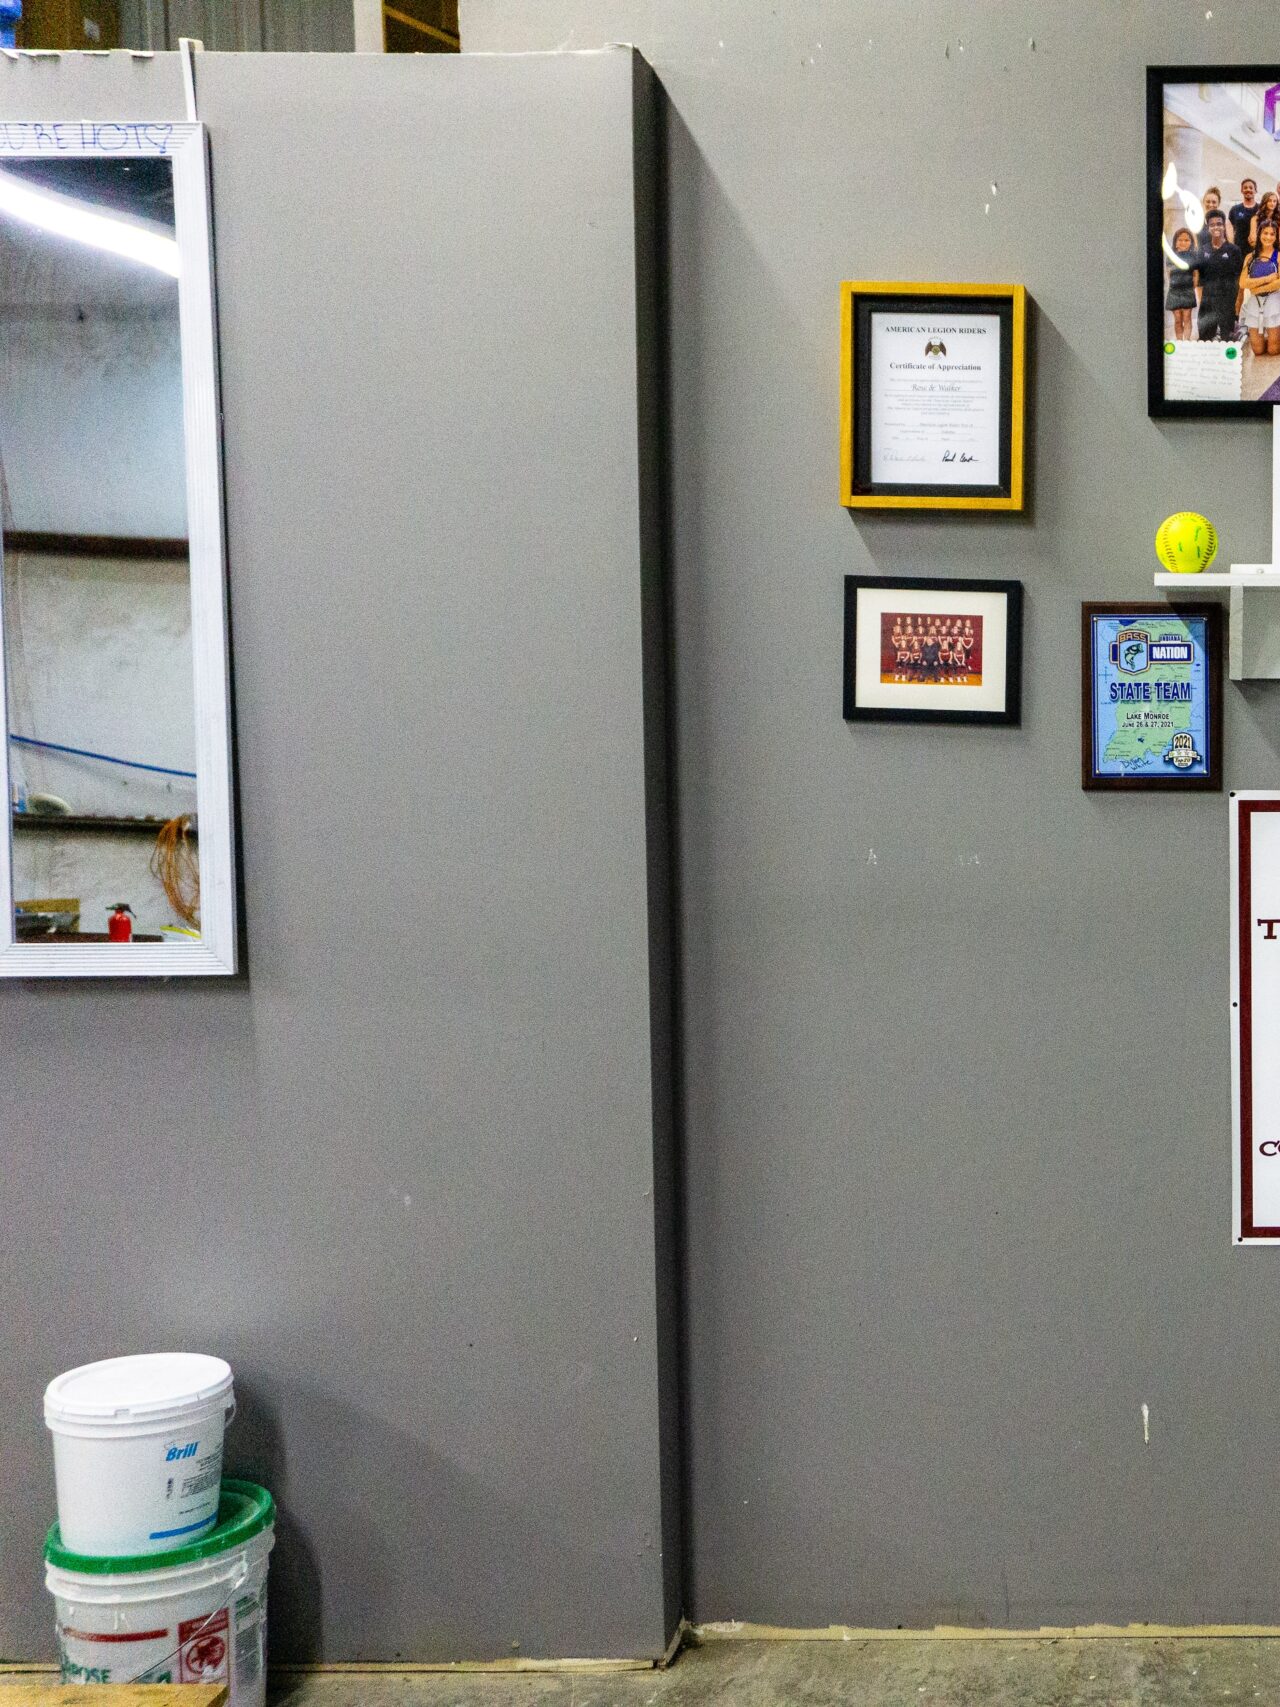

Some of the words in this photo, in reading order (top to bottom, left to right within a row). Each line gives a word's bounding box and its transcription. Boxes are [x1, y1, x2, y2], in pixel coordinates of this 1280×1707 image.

[958, 327, 987, 335] RIDERS
[889, 362, 926, 370] Certificate
[927, 362, 935, 370] of
[937, 363, 982, 371] Appreciation
[1152, 646, 1188, 659] NATION
[1110, 682, 1150, 700] STATE
[1154, 682, 1191, 700] TEAM
[1126, 712, 1142, 720] LAKE
[1143, 712, 1170, 720] MONROE
[1174, 735, 1191, 749] 2021
[166, 1441, 199, 1461] Brill
